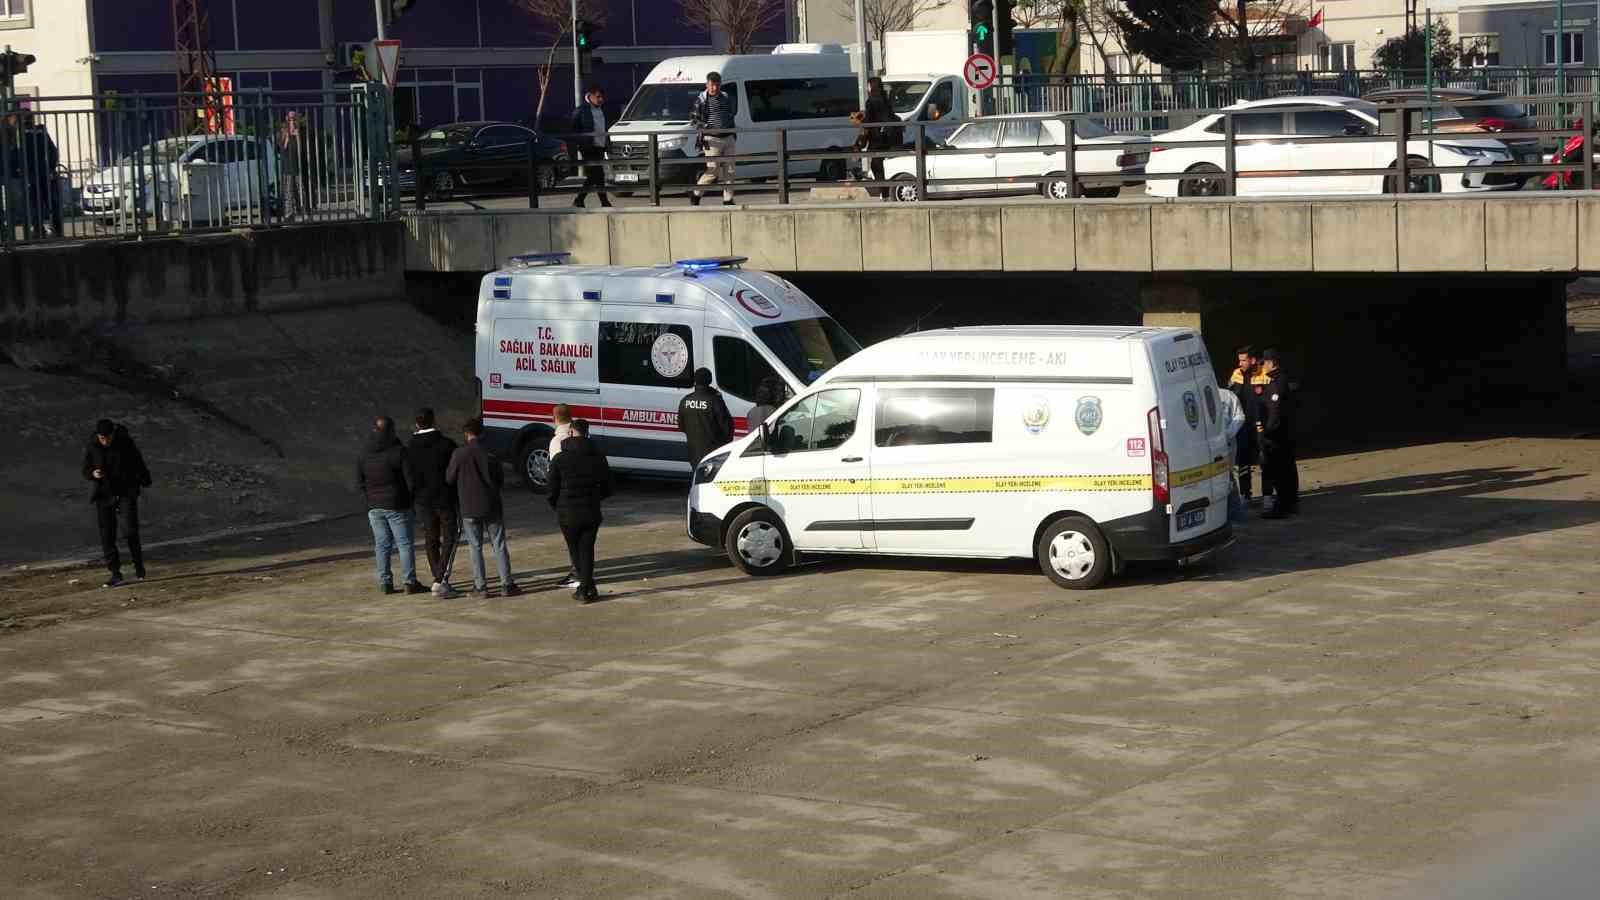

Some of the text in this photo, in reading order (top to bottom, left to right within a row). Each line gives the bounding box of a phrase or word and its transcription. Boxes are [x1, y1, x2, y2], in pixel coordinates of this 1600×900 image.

[538, 326, 554, 340] T.C.
[500, 338, 593, 359] SAĞLIK BAKANLIĞI
[540, 357, 577, 374] SAĞLIK
[1128, 440, 1144, 449] 112
